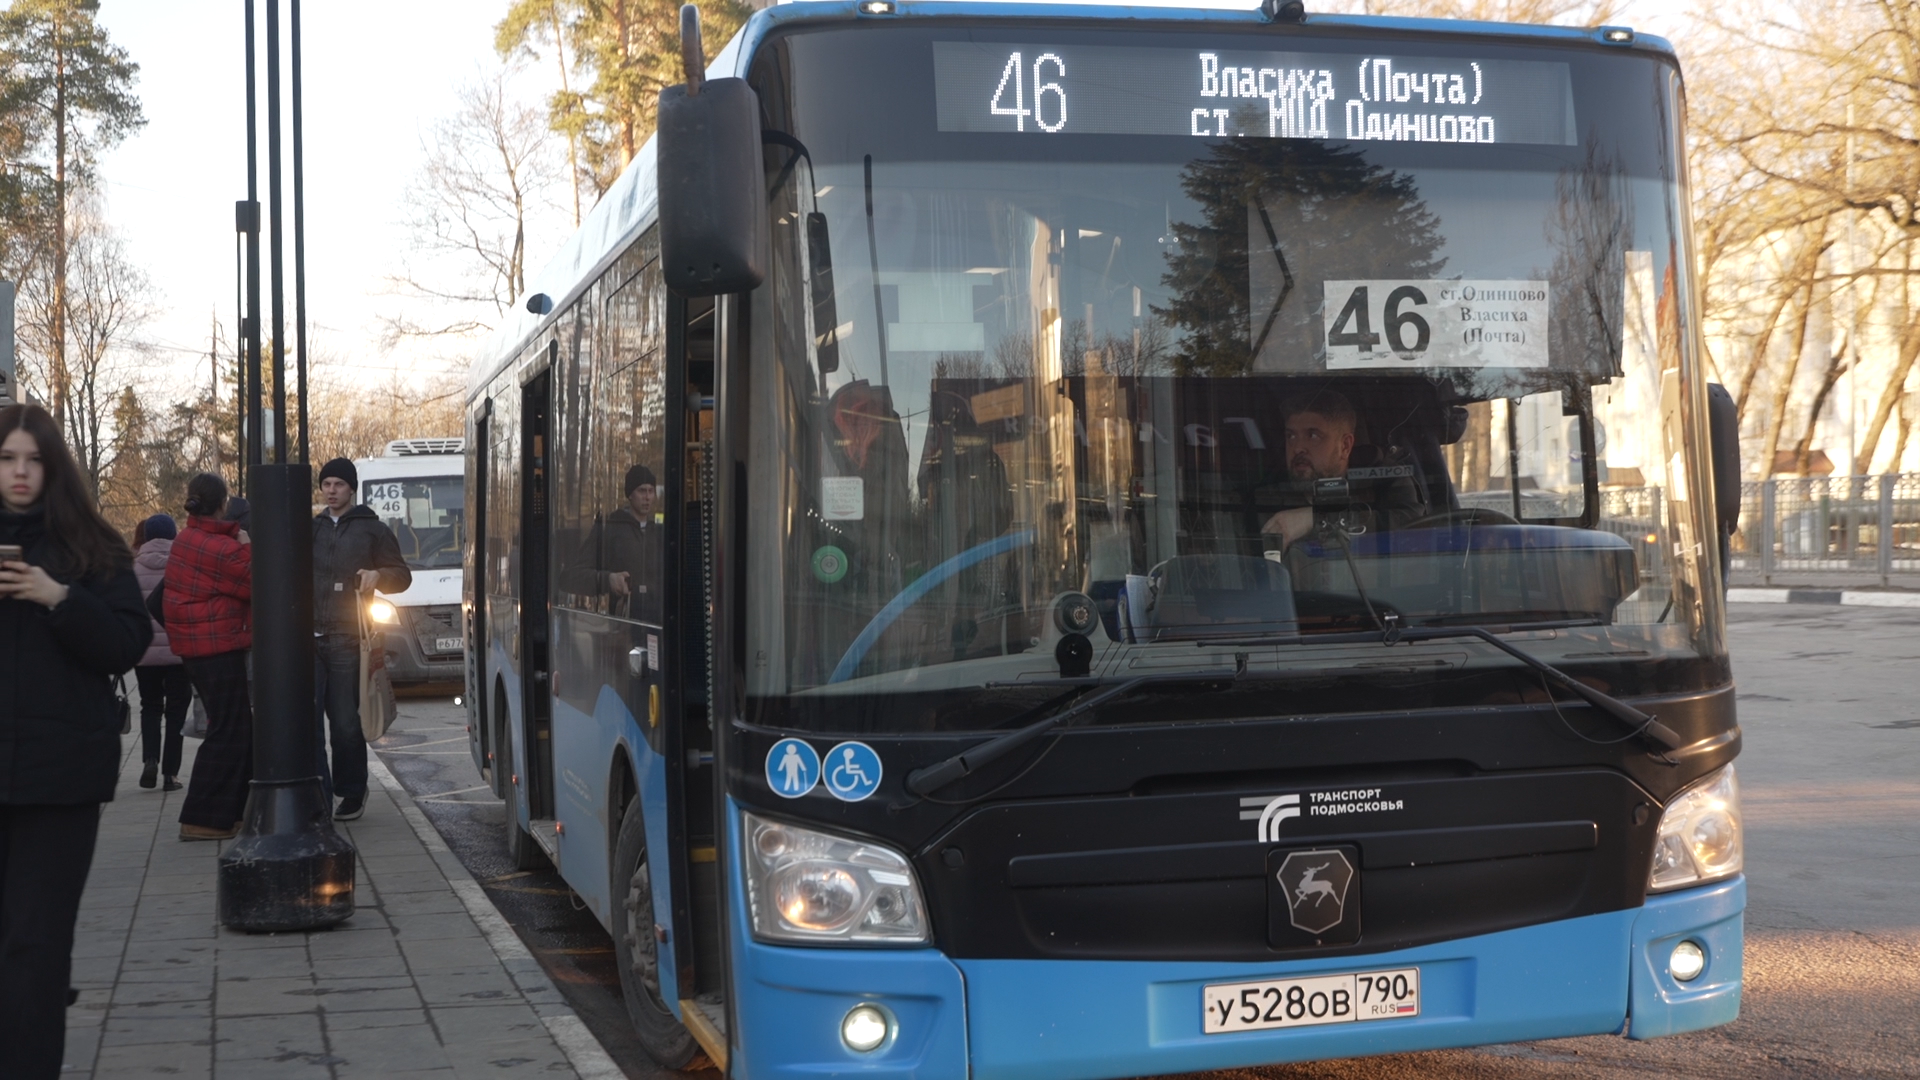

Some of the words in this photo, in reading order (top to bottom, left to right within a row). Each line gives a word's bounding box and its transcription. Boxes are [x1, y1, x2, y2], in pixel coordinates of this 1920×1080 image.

[1199, 53, 1335, 100] Власиха
[1358, 58, 1483, 105] (Почта)
[991, 52, 1067, 132] 46
[1191, 108, 1245, 137] ст.
[1346, 99, 1496, 143] Одинцово
[1328, 285, 1431, 361] 46
[1460, 307, 1529, 322] Власиха
[1463, 328, 1526, 346] (Почта)
[374, 484, 400, 500] 46
[382, 501, 400, 512] 46
[1310, 788, 1381, 803] ТРАНСПОРТ
[1310, 800, 1404, 816] ПОДМОСКОВЬЯ
[1358, 974, 1408, 1004] 790
[1371, 1004, 1396, 1015] RUS
